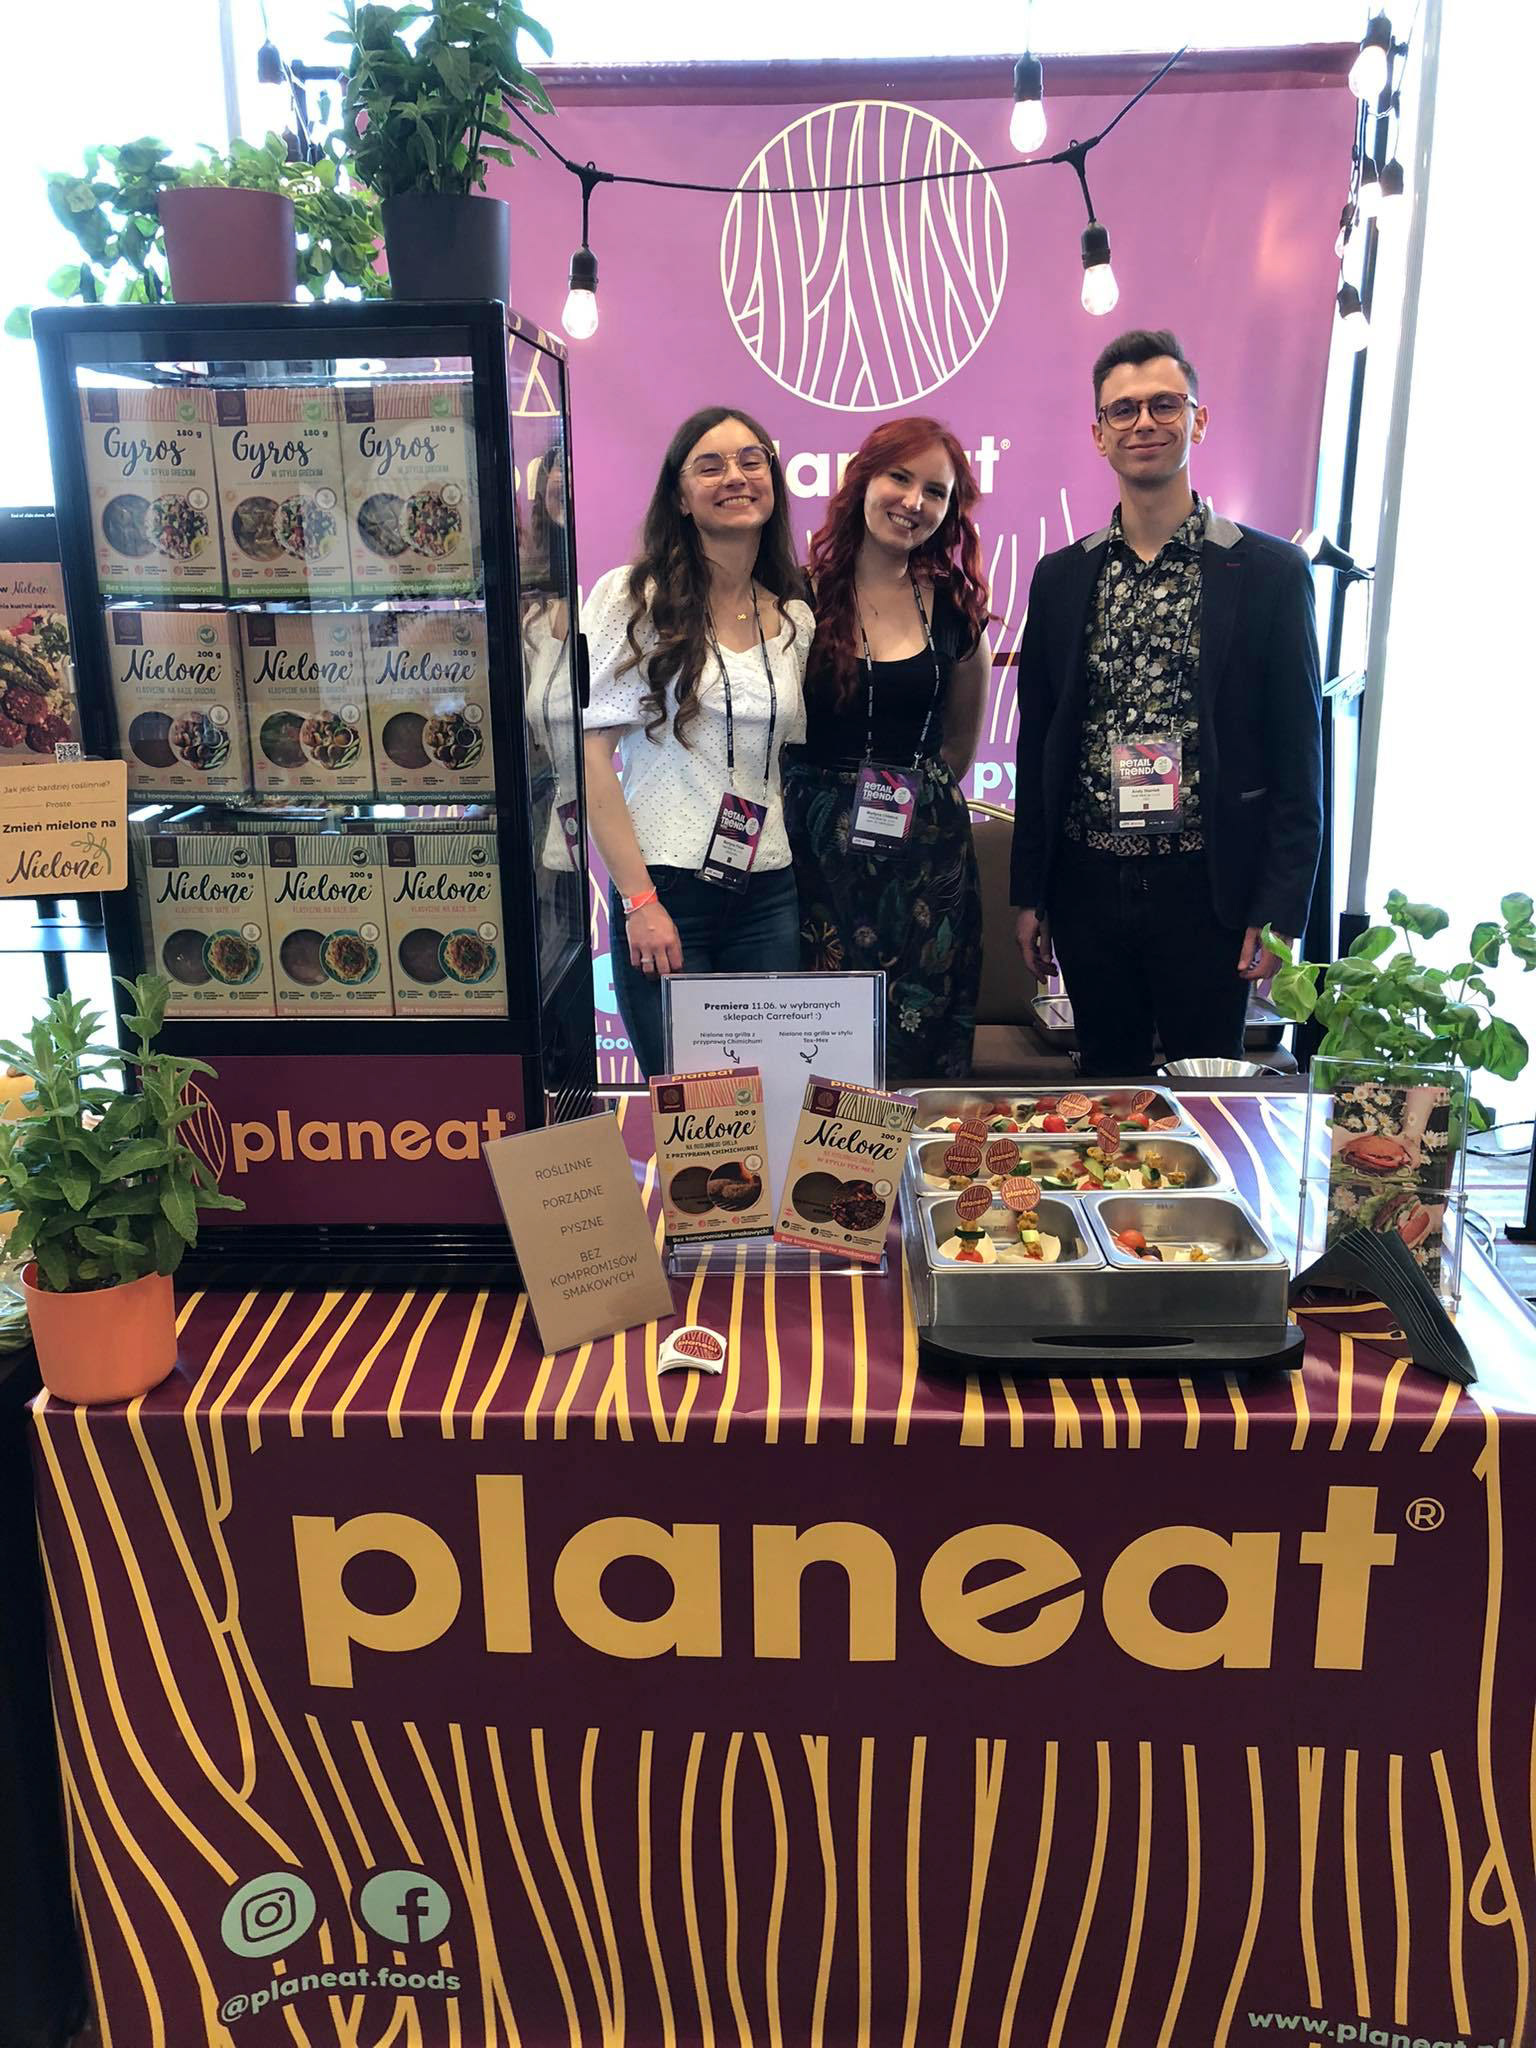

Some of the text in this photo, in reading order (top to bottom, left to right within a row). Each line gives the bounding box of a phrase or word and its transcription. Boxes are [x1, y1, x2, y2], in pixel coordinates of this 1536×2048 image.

[322, 430, 328, 438] g
[104, 427, 186, 476] Gyros
[232, 430, 312, 479] Gyros
[360, 426, 440, 476] Gyros
[12, 580, 47, 596] Nielone
[120, 649, 222, 684] Nielone
[253, 650, 352, 684] Nielone
[376, 650, 476, 684] Nielone
[18, 785, 35, 794] jeść
[37, 783, 70, 792] bardziej
[3, 820, 116, 833] Zmień mielone na
[6, 850, 104, 884] Nielone
[157, 871, 253, 903] Nielone
[274, 871, 372, 903] Nielone
[393, 871, 491, 903] Nielone
[704, 1002, 749, 1010] Premiera
[751, 1002, 777, 1010] 11.06.
[789, 1001, 840, 1011] wybranych
[723, 1013, 764, 1022] sklepach
[766, 1012, 813, 1020] Carrefour!
[664, 1115, 756, 1145] Nielone
[804, 1120, 898, 1160] Nielone
[712, 1145, 759, 1155] CHIMICHURRI
[536, 1158, 593, 1181] ROŚLINNE
[542, 1185, 604, 1209] PORZĄDNE
[1005, 1188, 1036, 1199] planeat
[560, 1216, 604, 1236] PYSZNE
[550, 1253, 638, 1288] KOMPROMISÓW
[579, 1248, 601, 1263] BEZ
[562, 1270, 636, 1300] SMAKOWYCH
[678, 1340, 718, 1352] planeat
[221, 1966, 461, 2022] @planeat.foods
